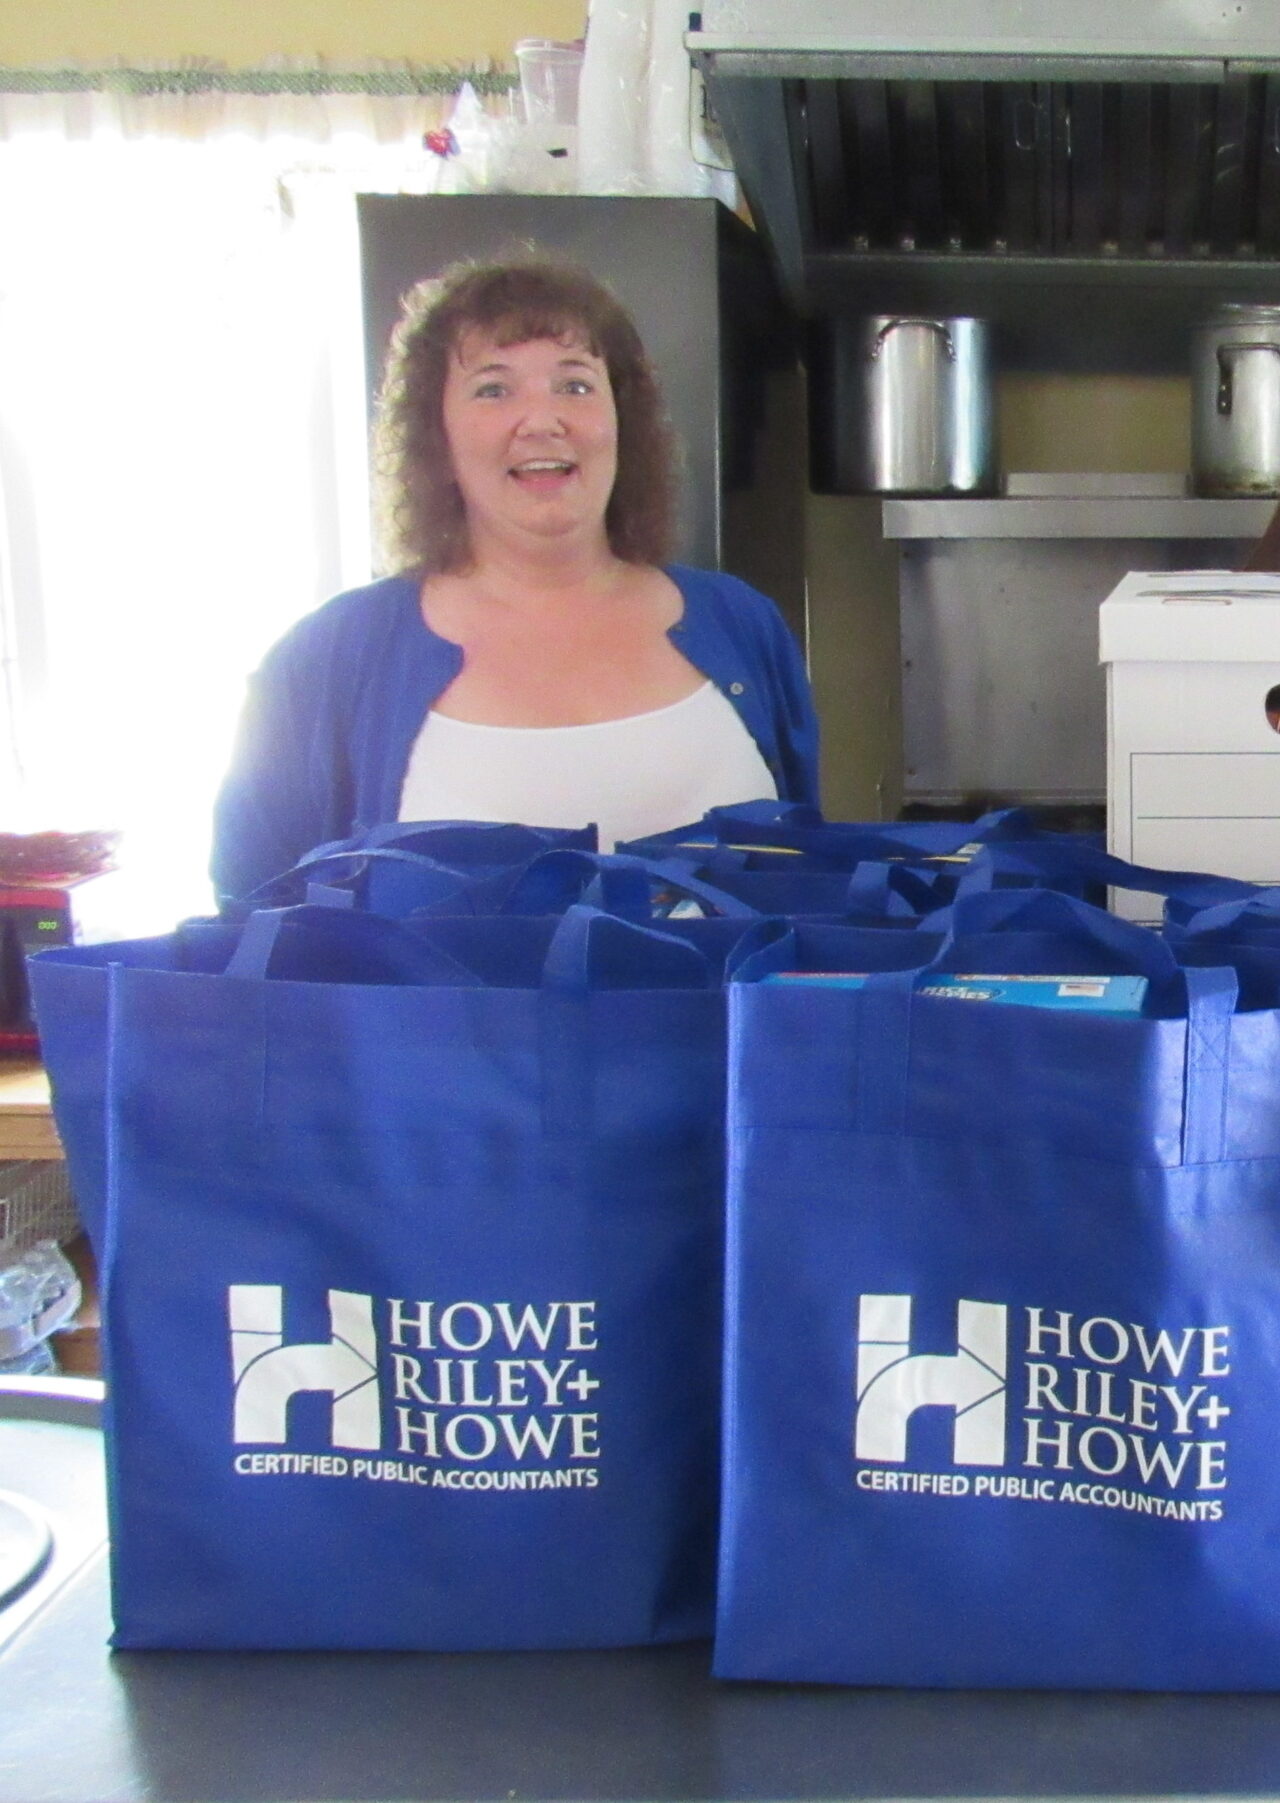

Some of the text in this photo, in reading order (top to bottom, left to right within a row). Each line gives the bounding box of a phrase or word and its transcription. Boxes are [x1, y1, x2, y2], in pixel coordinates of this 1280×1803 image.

[387, 1299, 599, 1352] HOWE
[1024, 1306, 1231, 1377] HOWE
[394, 1353, 600, 1407] RILEY+
[1024, 1362, 1230, 1434] RILEY+
[395, 1406, 601, 1460] HOWE
[1022, 1418, 1227, 1490] HOWE
[234, 1453, 599, 1491] CERTIFIED PUBLIC ACCOUNTANTS
[856, 1469, 1223, 1522] CERTIFIED PUBLIC ACCOUNTANTS
